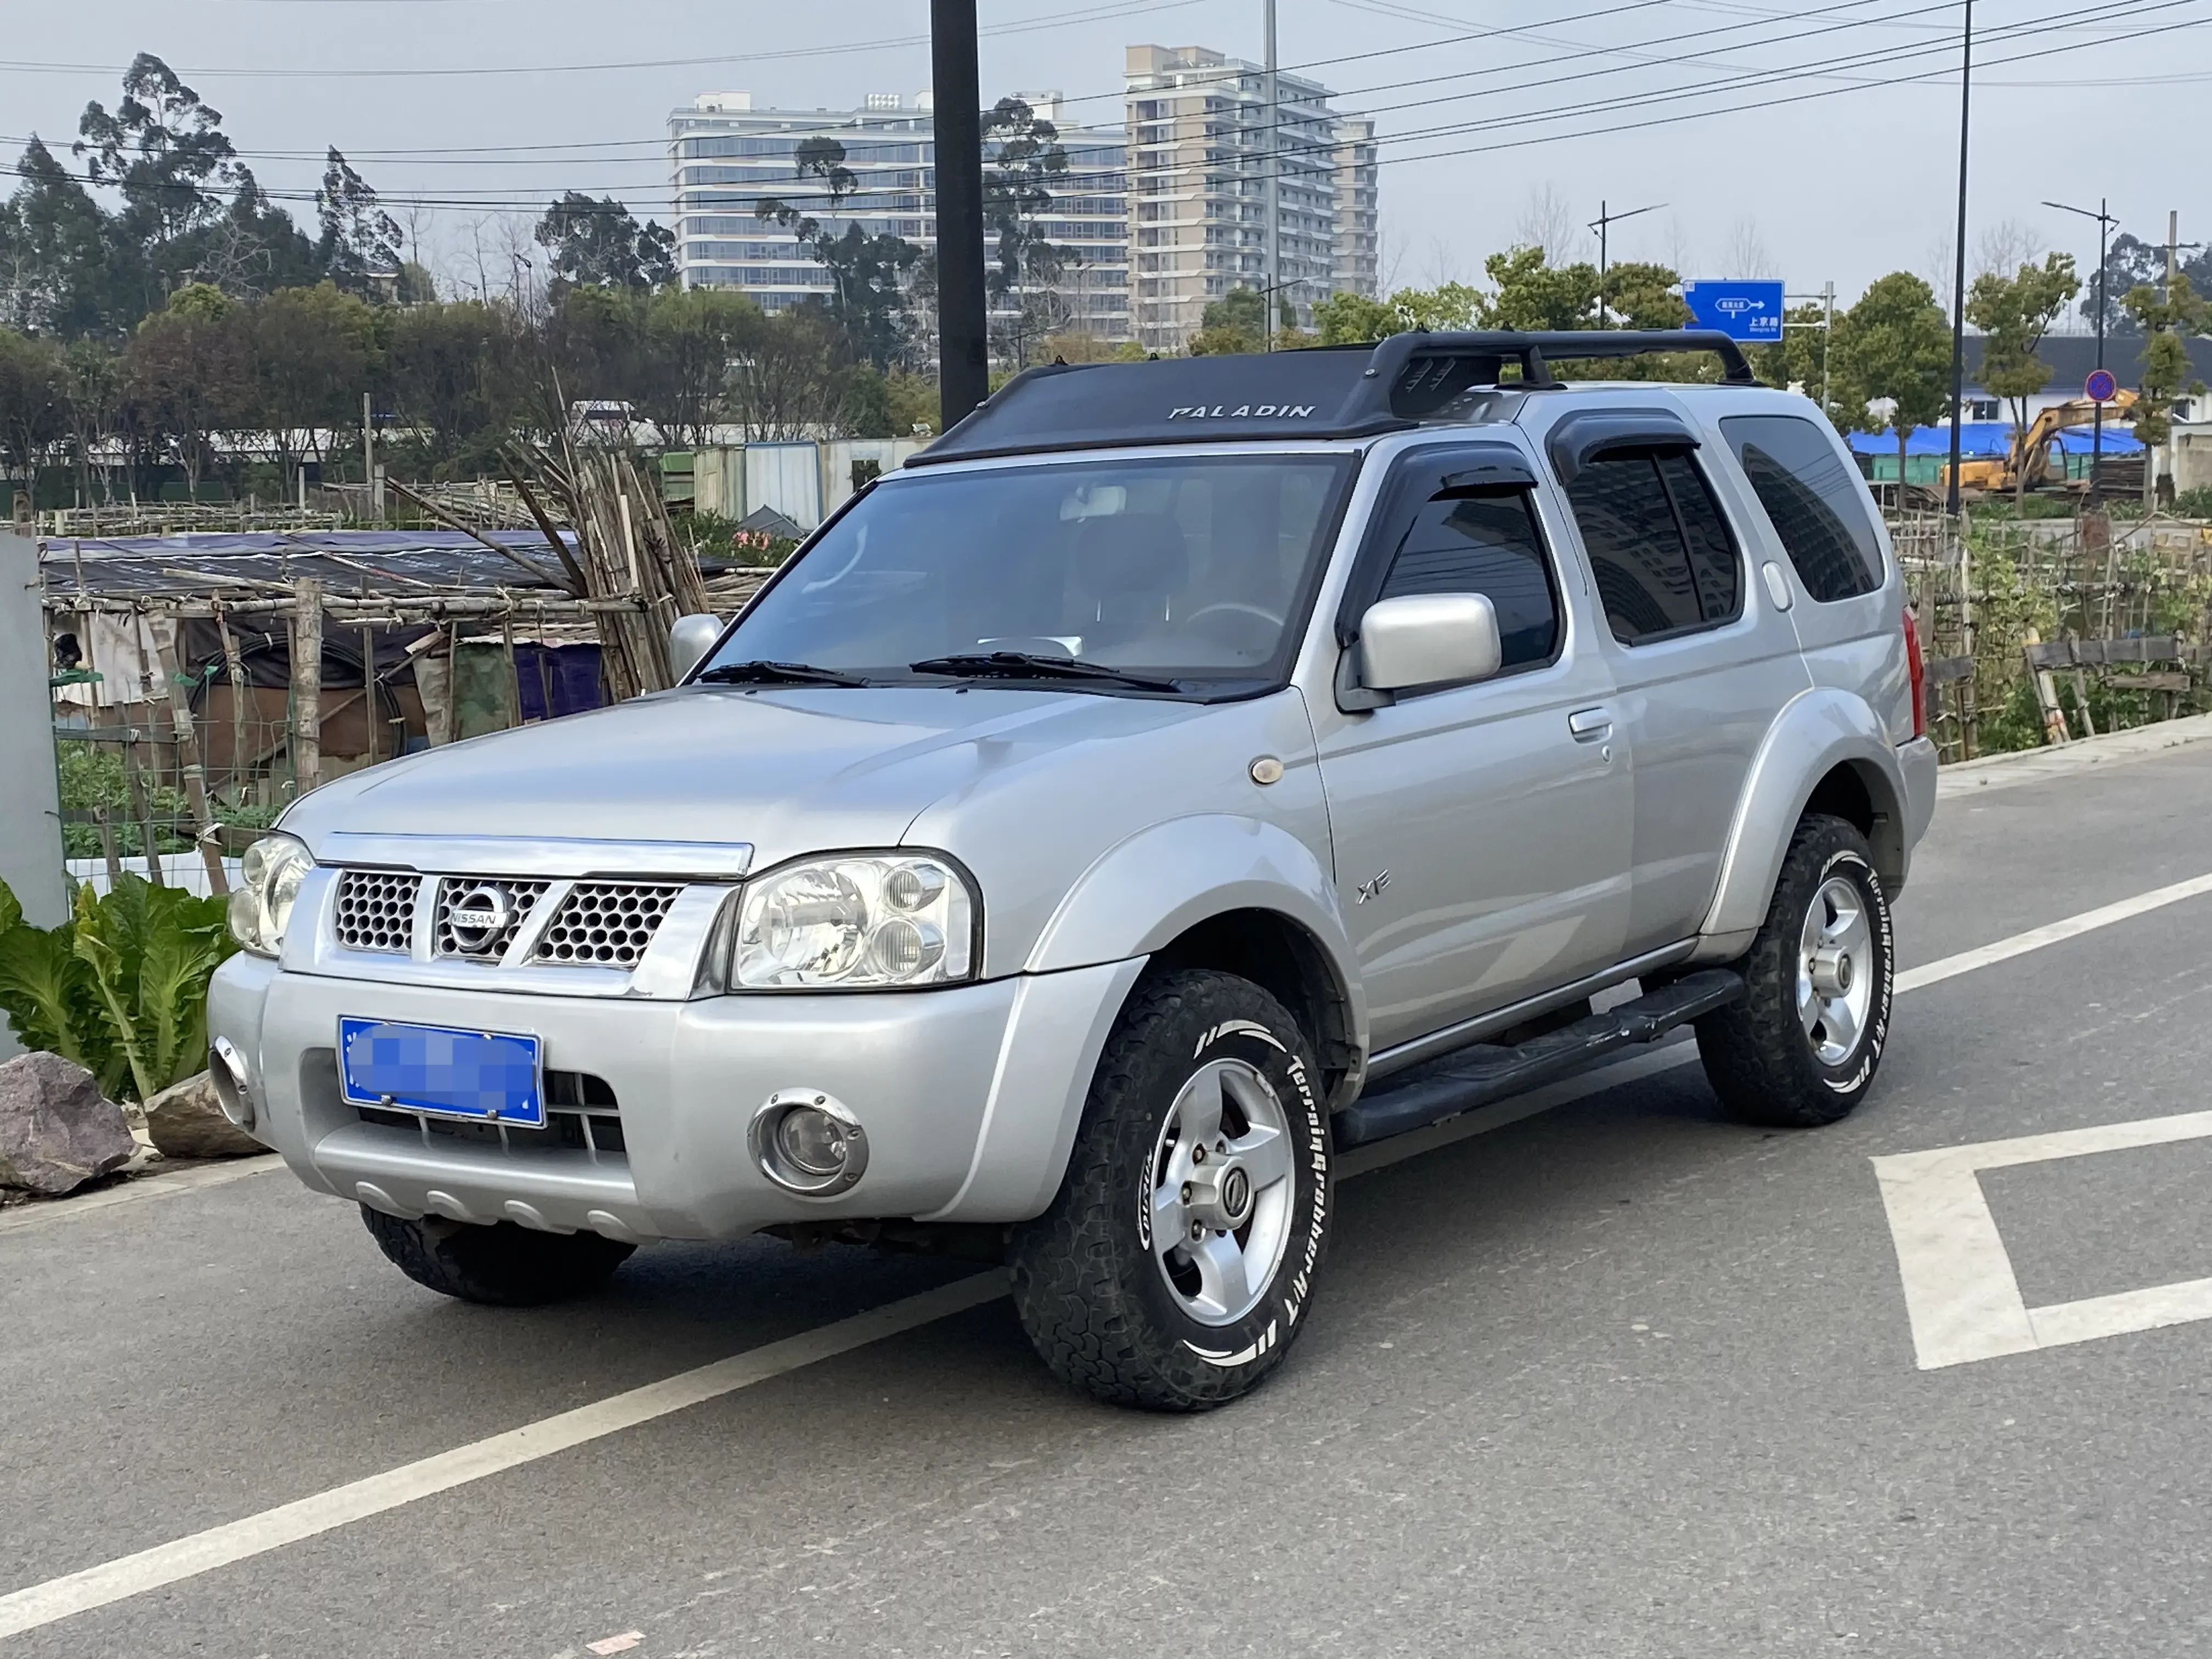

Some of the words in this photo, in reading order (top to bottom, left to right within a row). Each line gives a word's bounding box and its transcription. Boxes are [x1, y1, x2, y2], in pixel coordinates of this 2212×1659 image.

[1167, 404, 1316, 419] PALADIN
[1356, 868, 1391, 904] XE
[452, 913, 496, 924] NISSAN
